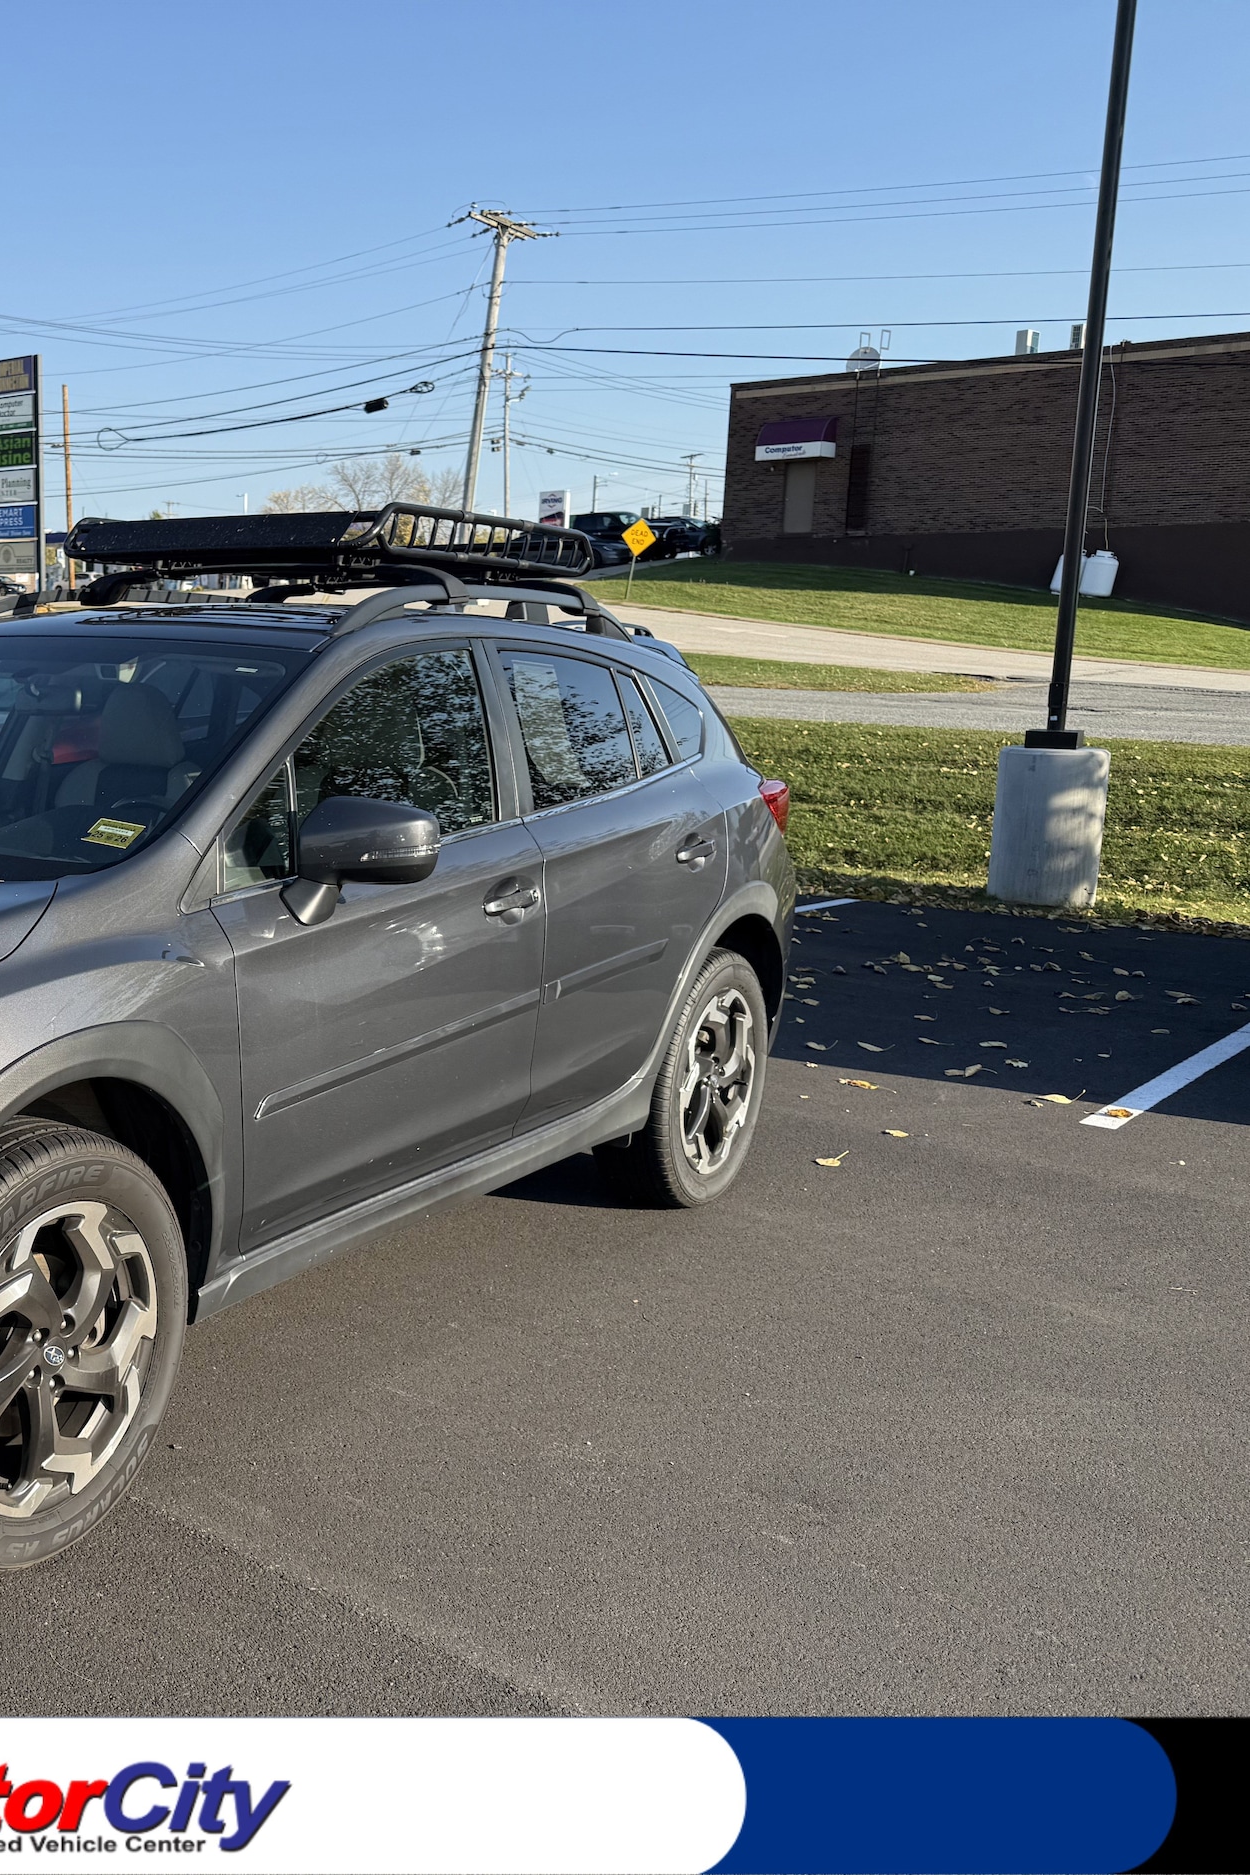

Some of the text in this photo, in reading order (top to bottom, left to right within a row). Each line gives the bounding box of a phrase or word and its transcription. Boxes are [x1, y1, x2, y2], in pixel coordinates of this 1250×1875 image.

[764, 445, 803, 454] Computer
[1, 477, 31, 490] Planning
[630, 529, 649, 537] DEAD
[114, 835, 129, 843] 26
[3, 1432, 149, 1558] SOLARUS AS
